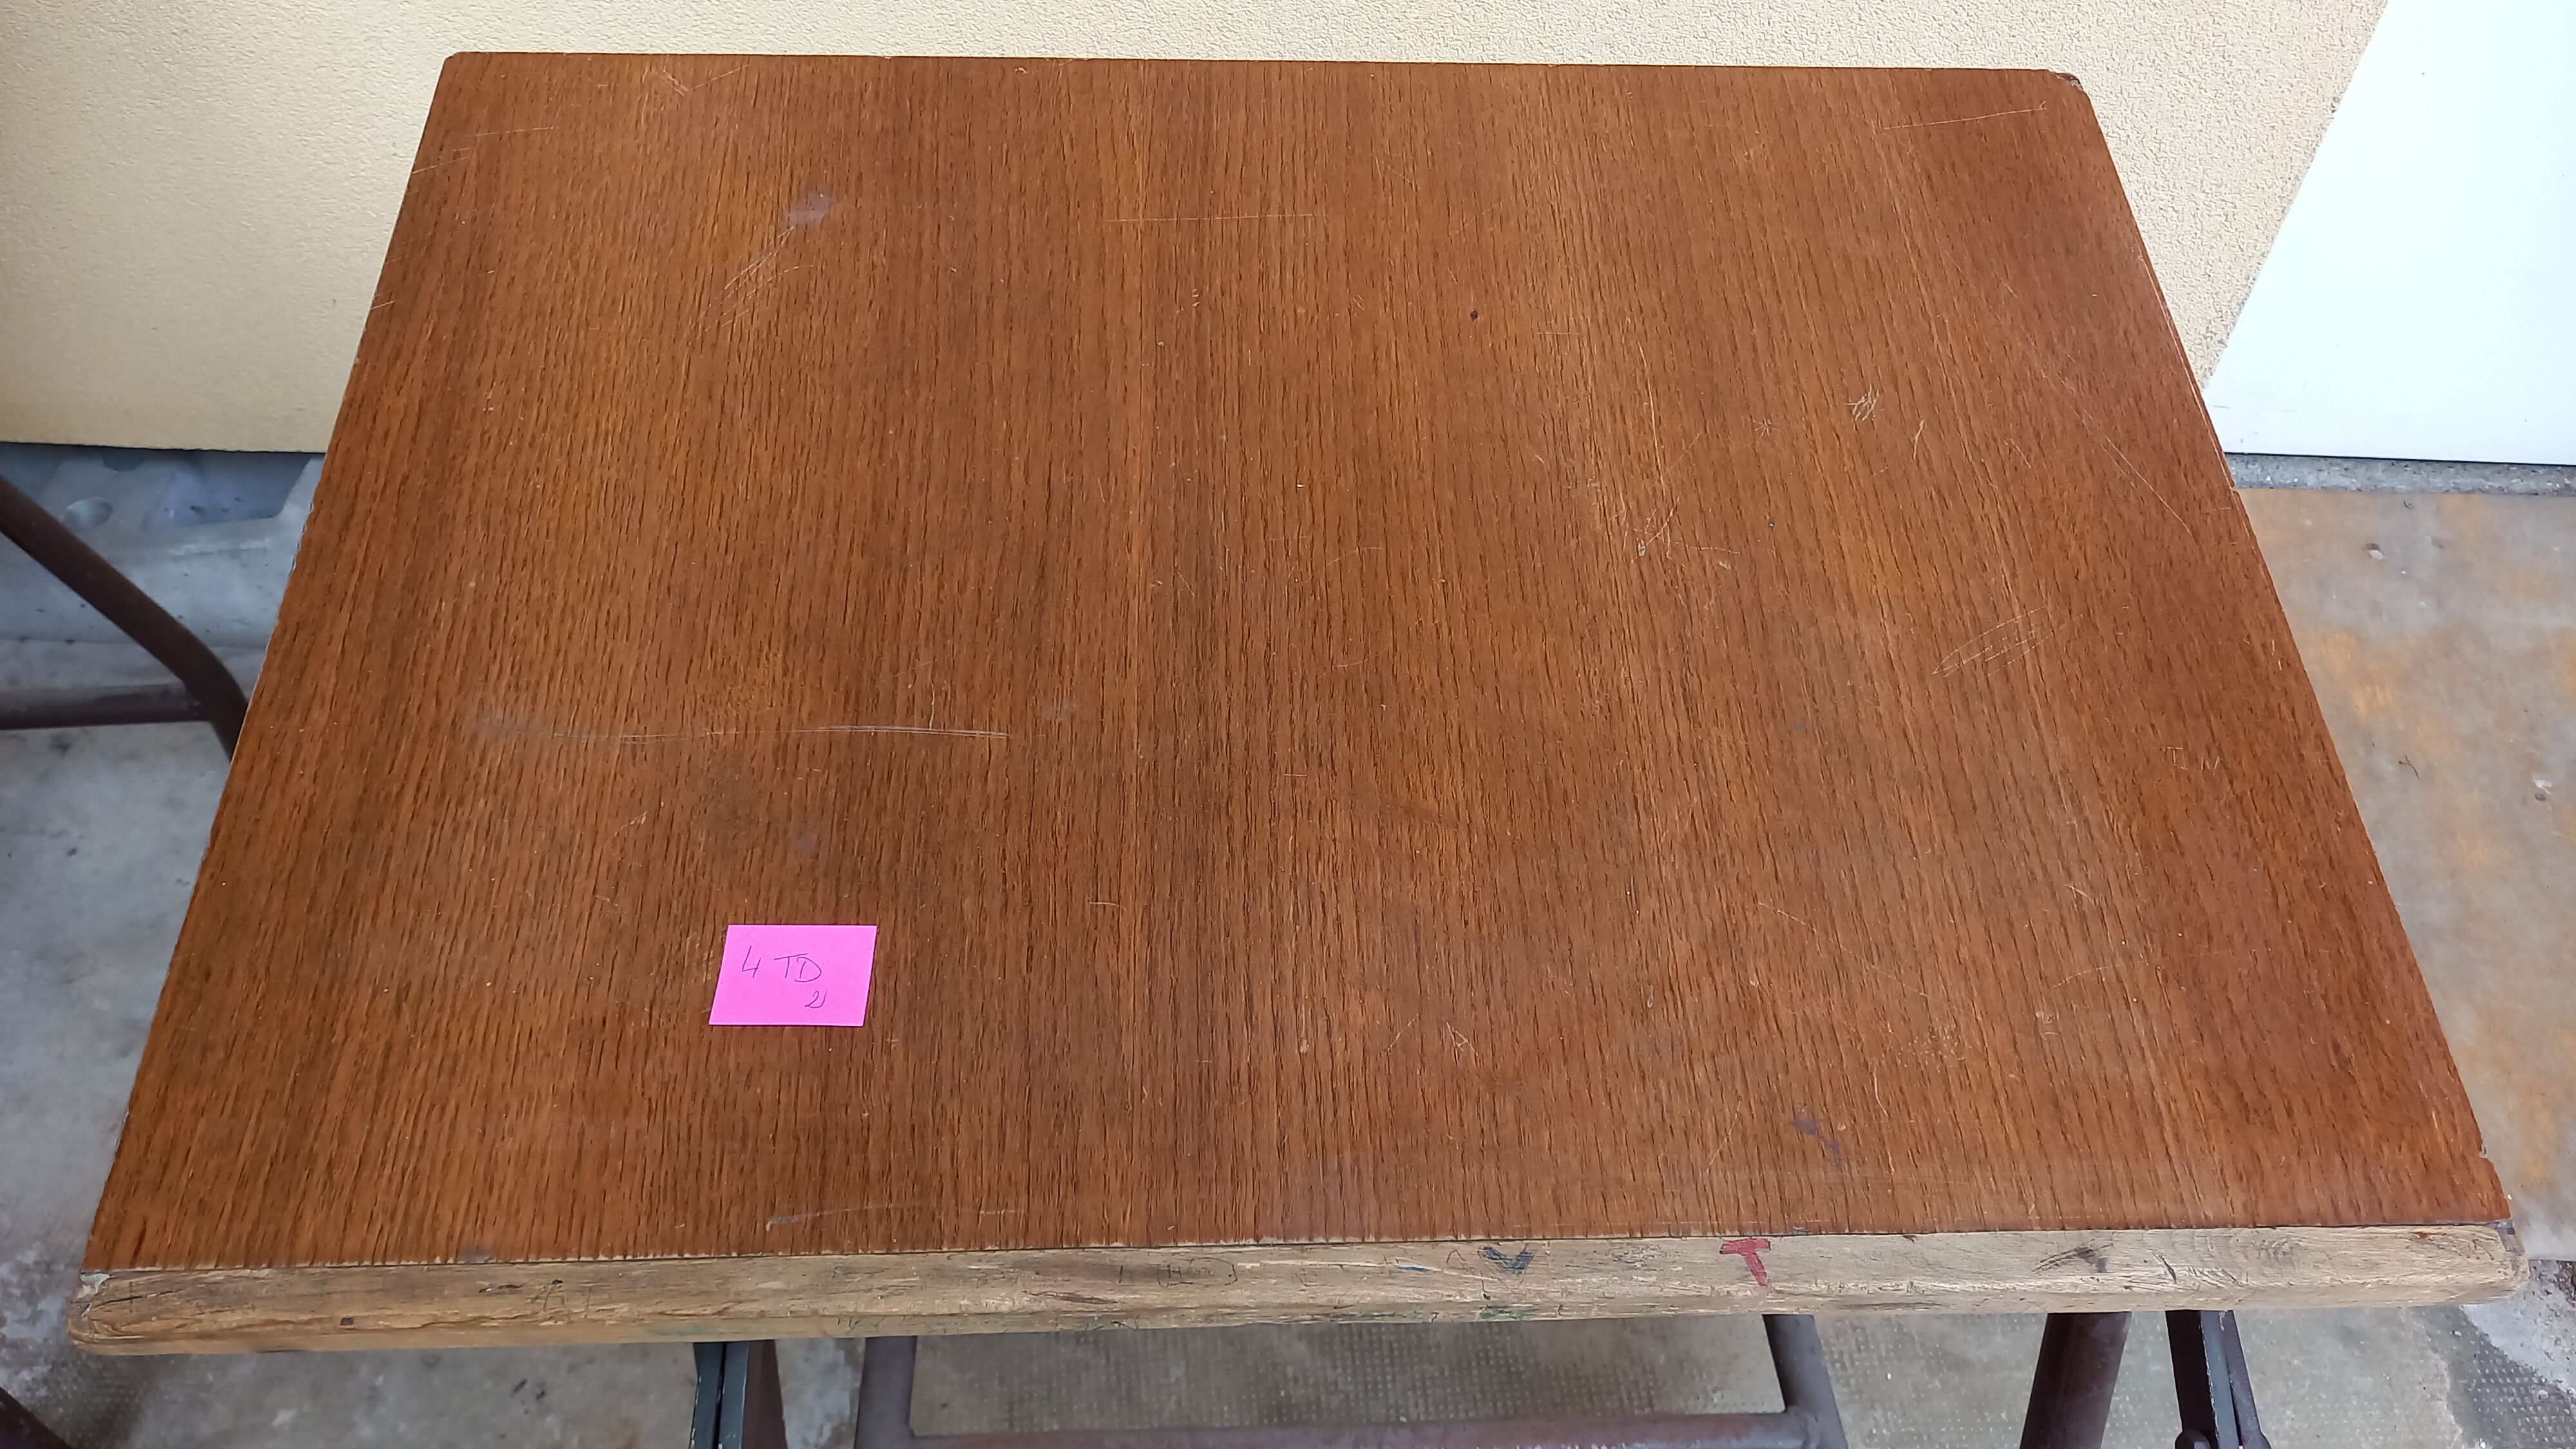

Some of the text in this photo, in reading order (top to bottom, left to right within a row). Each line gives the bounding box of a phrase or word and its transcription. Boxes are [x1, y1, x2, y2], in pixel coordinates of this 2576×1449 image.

[741, 945, 822, 983] 4 TD
[1718, 1237, 1772, 1287] T
